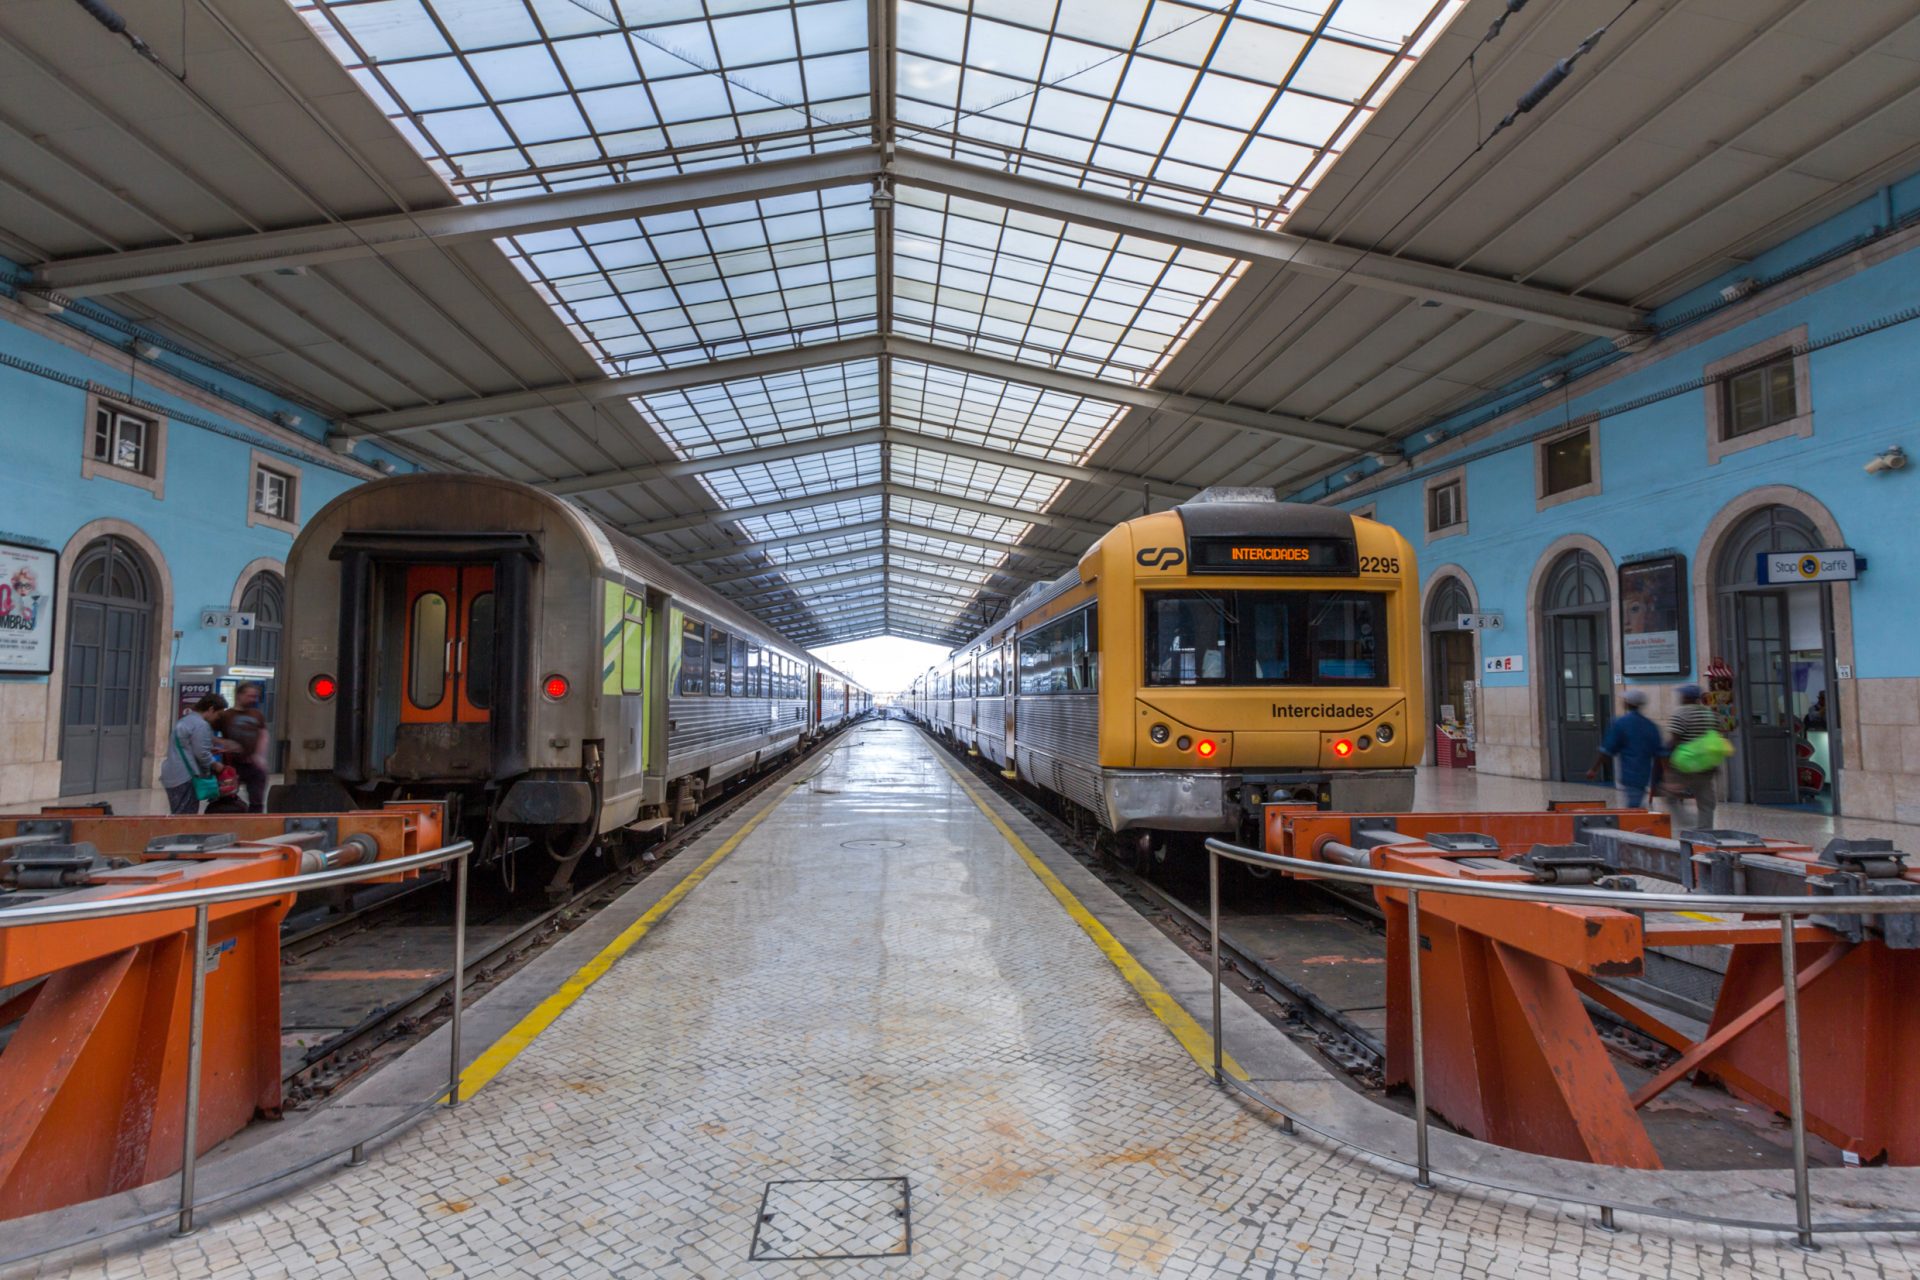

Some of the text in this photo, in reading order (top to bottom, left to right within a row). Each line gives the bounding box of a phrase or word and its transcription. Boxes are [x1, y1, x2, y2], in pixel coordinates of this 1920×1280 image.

[1231, 547, 1309, 562] INTERCIDADES
[1360, 556, 1400, 574] 2295
[1775, 559, 1848, 573] Stop Caffè
[182, 685, 210, 693] FOTOS
[1272, 703, 1374, 718] Intercidades
